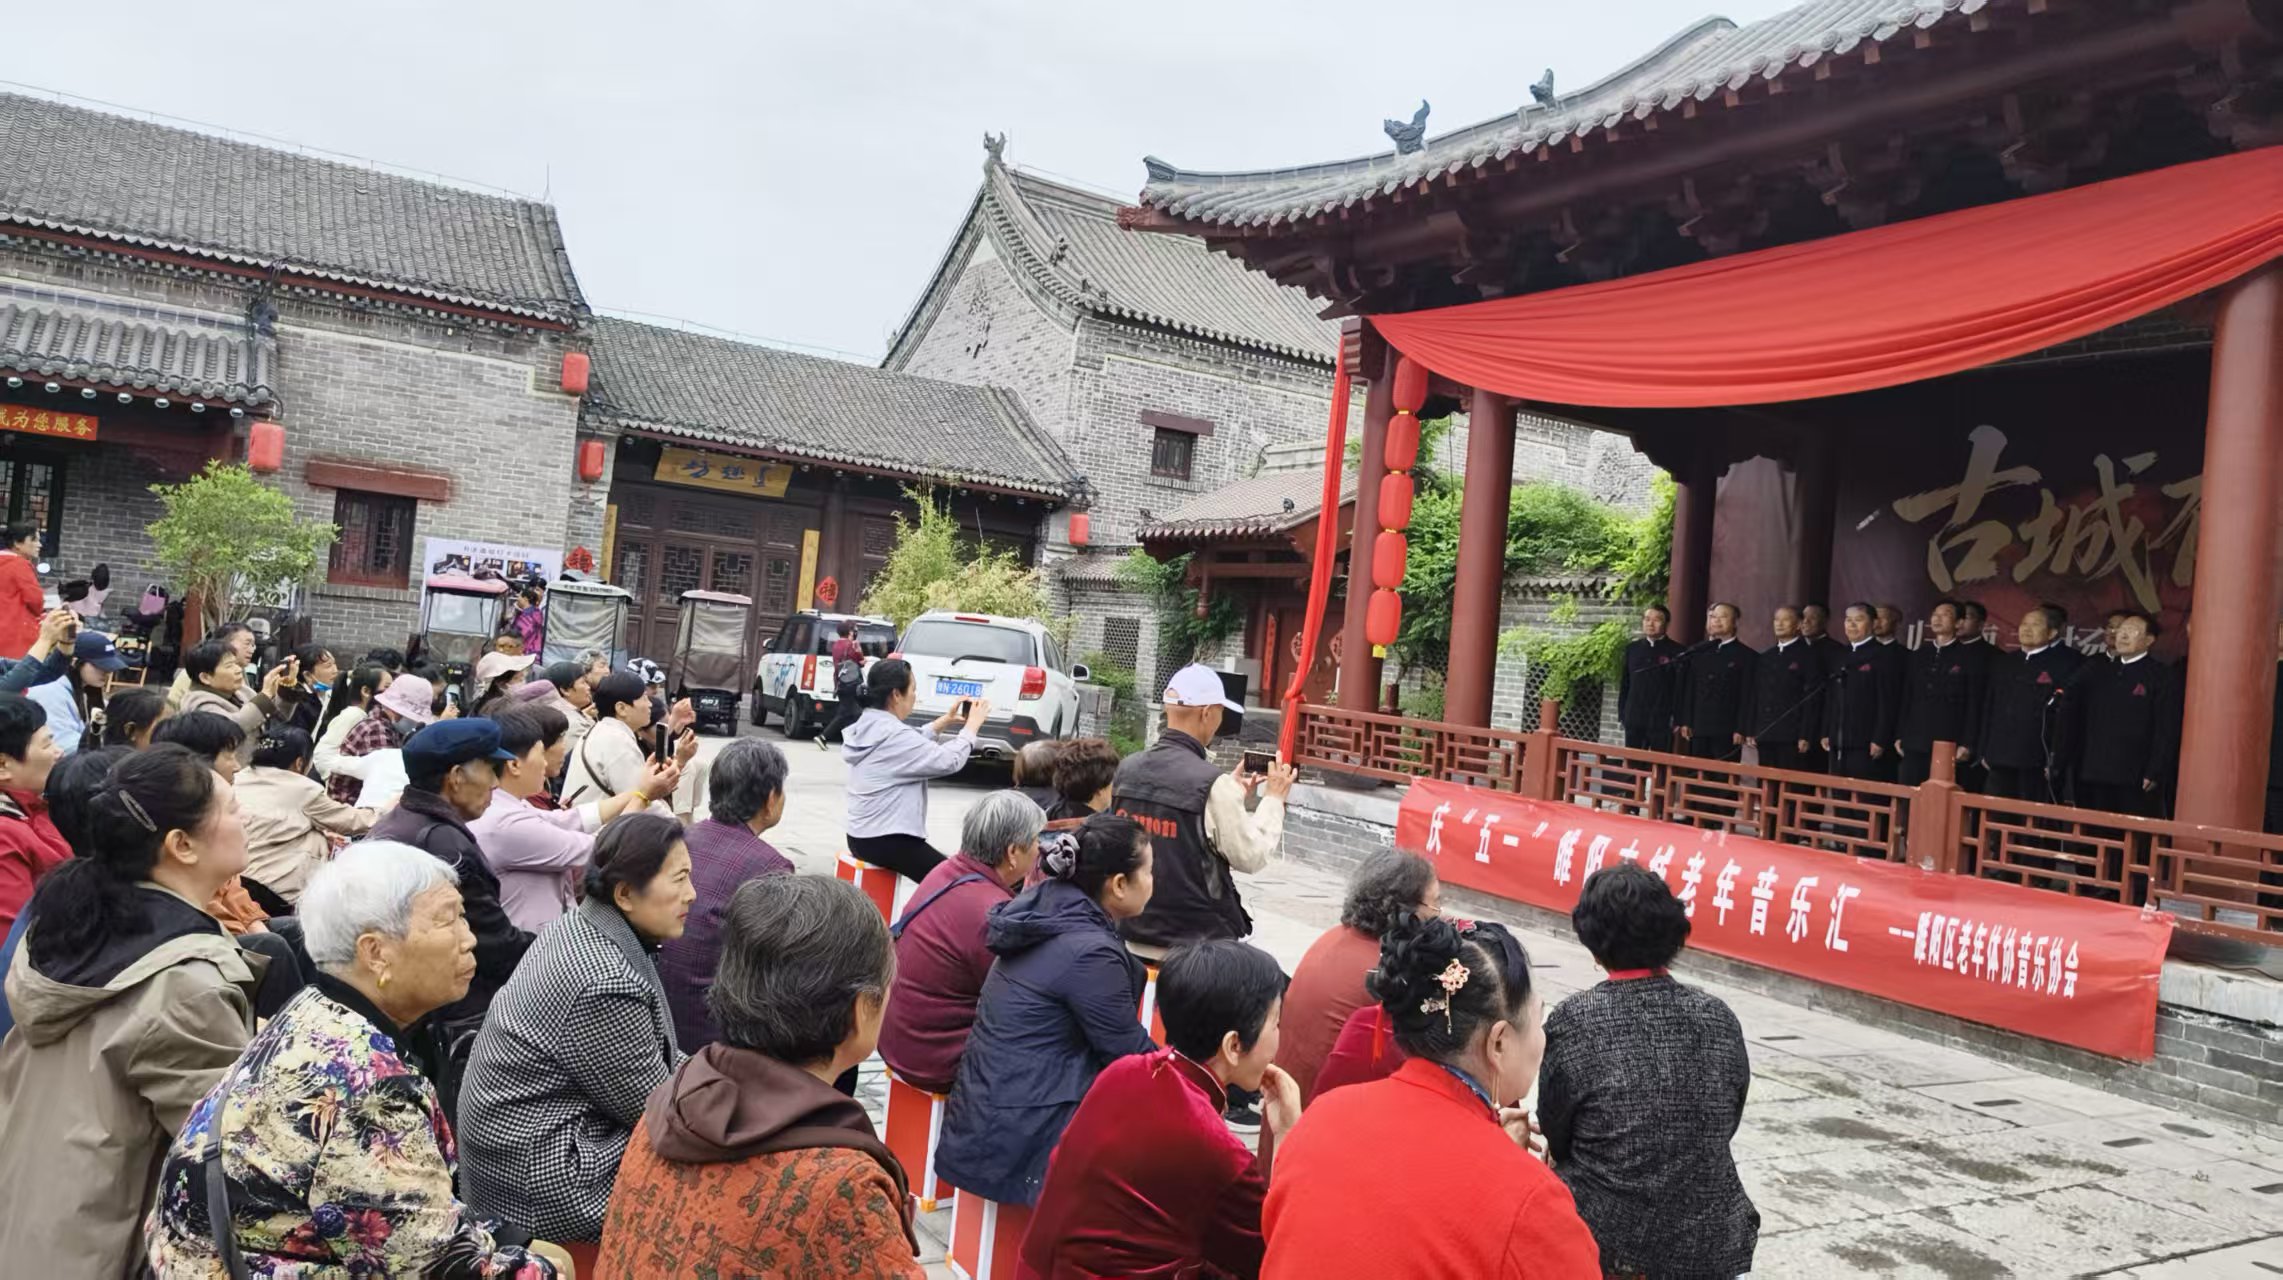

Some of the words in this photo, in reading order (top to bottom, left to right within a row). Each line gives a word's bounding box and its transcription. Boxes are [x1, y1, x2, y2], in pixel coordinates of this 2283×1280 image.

[1116, 808, 1177, 838] non
[1426, 801, 1861, 953] 庆“五一”睢阳老年音乐汇
